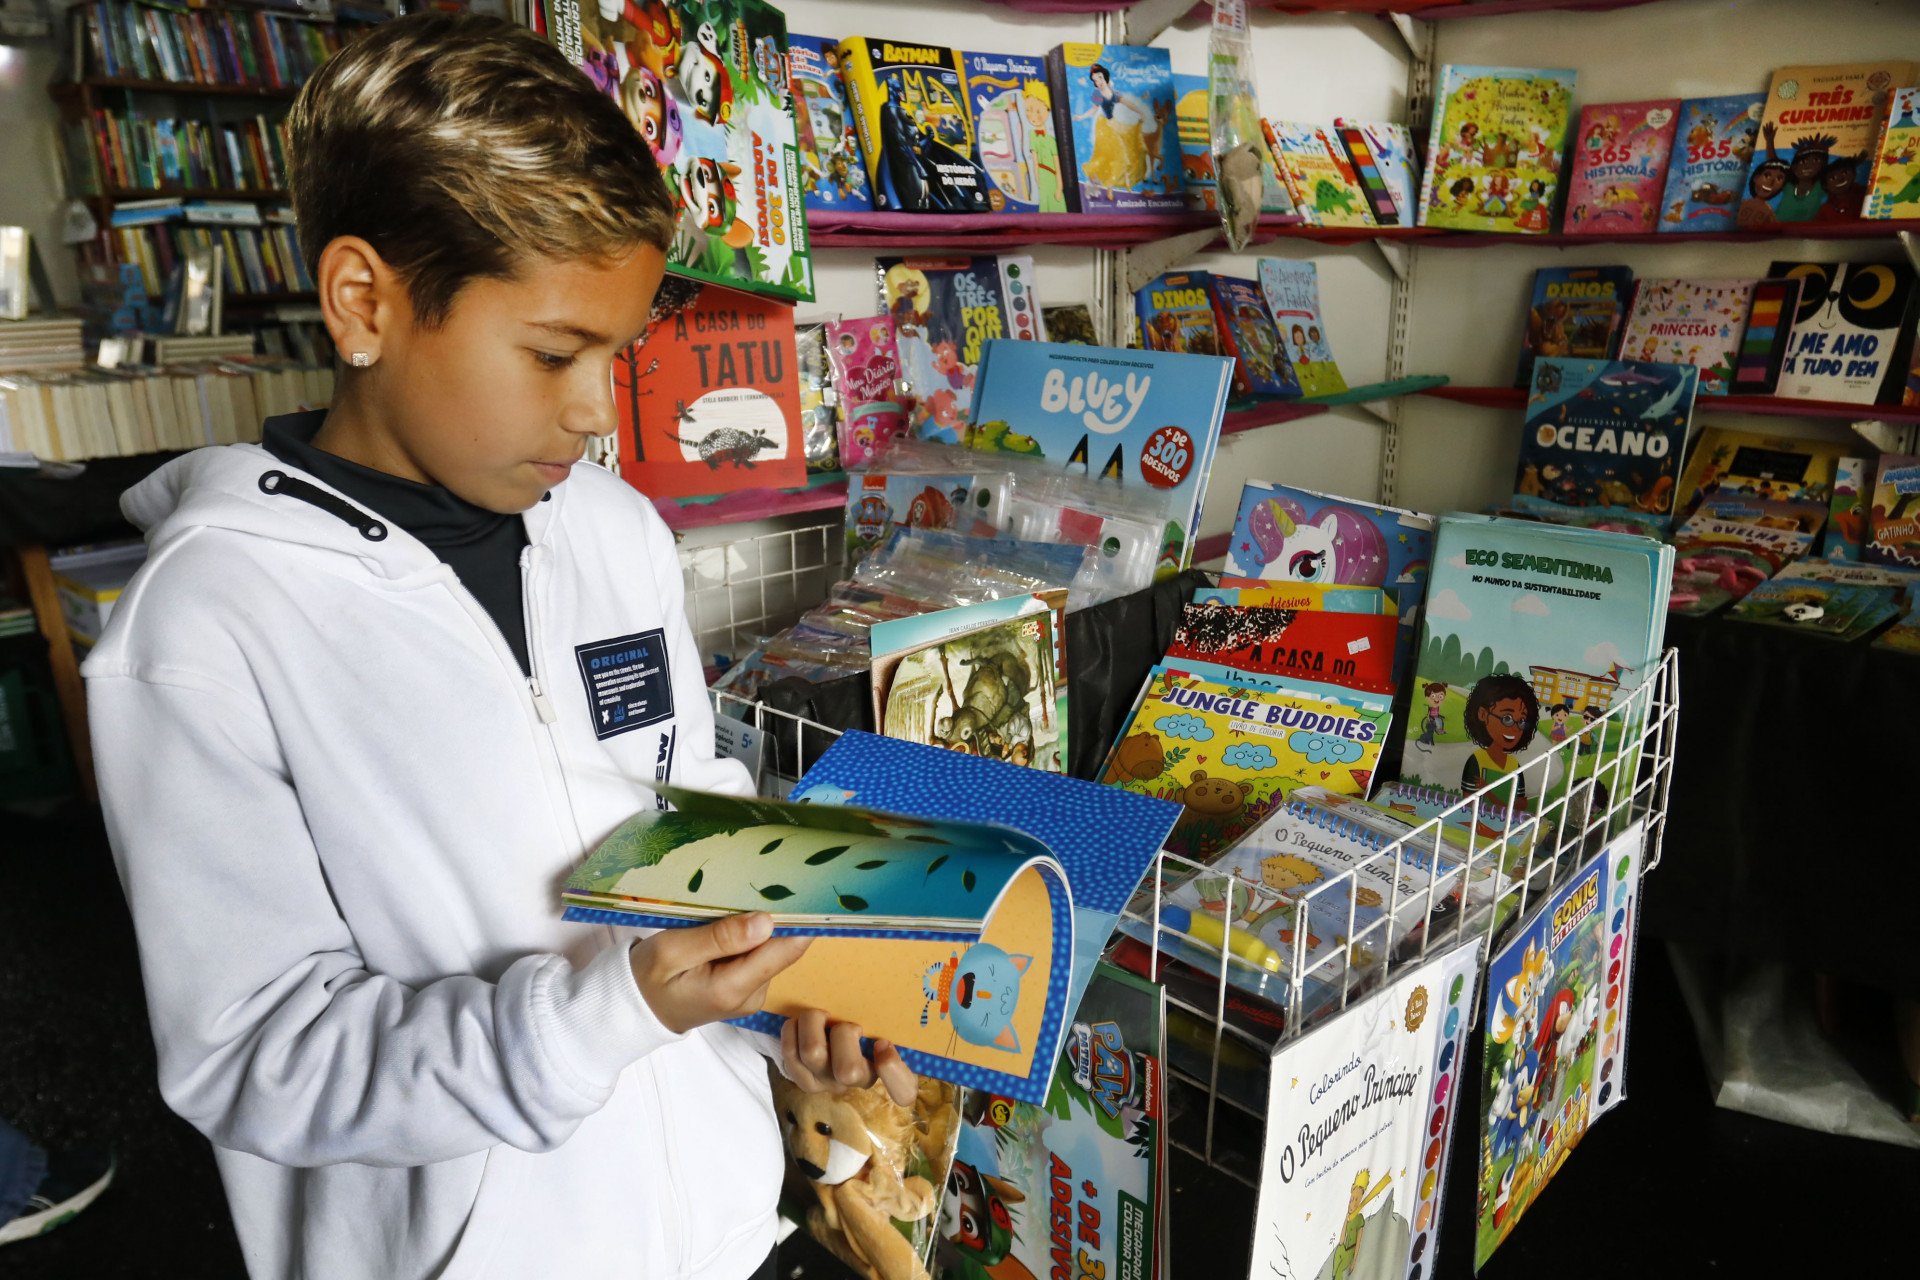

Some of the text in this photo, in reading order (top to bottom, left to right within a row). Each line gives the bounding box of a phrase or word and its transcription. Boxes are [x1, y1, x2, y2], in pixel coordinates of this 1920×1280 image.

[883, 43, 940, 64] BATMAN
[1808, 84, 1854, 107] TRÊS
[1779, 105, 1874, 125] CURUMINS
[1589, 144, 1632, 167] 365
[1687, 138, 1732, 163] 365
[766, 159, 778, 188] DE
[1584, 162, 1658, 180] HISTÓRIAS
[752, 131, 770, 247] ADESIVOS!
[769, 191, 785, 245] 300
[953, 272, 977, 291] OS
[1546, 281, 1616, 298] DINOS
[955, 285, 997, 308] TRÊS
[1152, 288, 1207, 310] DINOS
[674, 311, 765, 341] A CASA DO
[961, 305, 1001, 327] POR
[1650, 322, 1717, 337] PRINCESAS
[1800, 333, 1829, 354] ME
[1830, 333, 1878, 357] AMO
[691, 339, 783, 388] TATU
[863, 361, 894, 384] Diário
[1803, 358, 1842, 376] TUDO
[1845, 360, 1880, 378] BEM
[1041, 368, 1151, 434] BLUEY
[1149, 435, 1187, 470] 300
[1537, 424, 1669, 458] OCEANO
[1142, 453, 1181, 484] ADESIVOS
[1712, 524, 1783, 542] OVELHA
[1877, 523, 1916, 541] GATINHO
[1465, 549, 1613, 584] ECO SEMENTINHA
[1472, 575, 1601, 600] NO MUNDO DA SUSTENTABILIDADE
[1263, 596, 1312, 608] Adesivos
[591, 647, 649, 669] ORIGINAL
[1162, 687, 1377, 741] JUNGLE BUDDIES
[741, 733, 753, 748] 5+
[1230, 721, 1247, 730] LIVRO
[1258, 726, 1284, 738] COLORIR
[1275, 828, 1353, 864] O Pequeno
[1553, 873, 1597, 937] SONIC
[1552, 932, 1563, 948] THE
[1076, 1031, 1088, 1082] PATROL
[1092, 1021, 1125, 1120] PAW
[1309, 1052, 1362, 1105] Colorindo
[1280, 1144, 1294, 1184] O
[1298, 1091, 1360, 1168] Pequeno
[1079, 1200, 1101, 1251] DE
[1123, 1201, 1132, 1260] COLORIR
